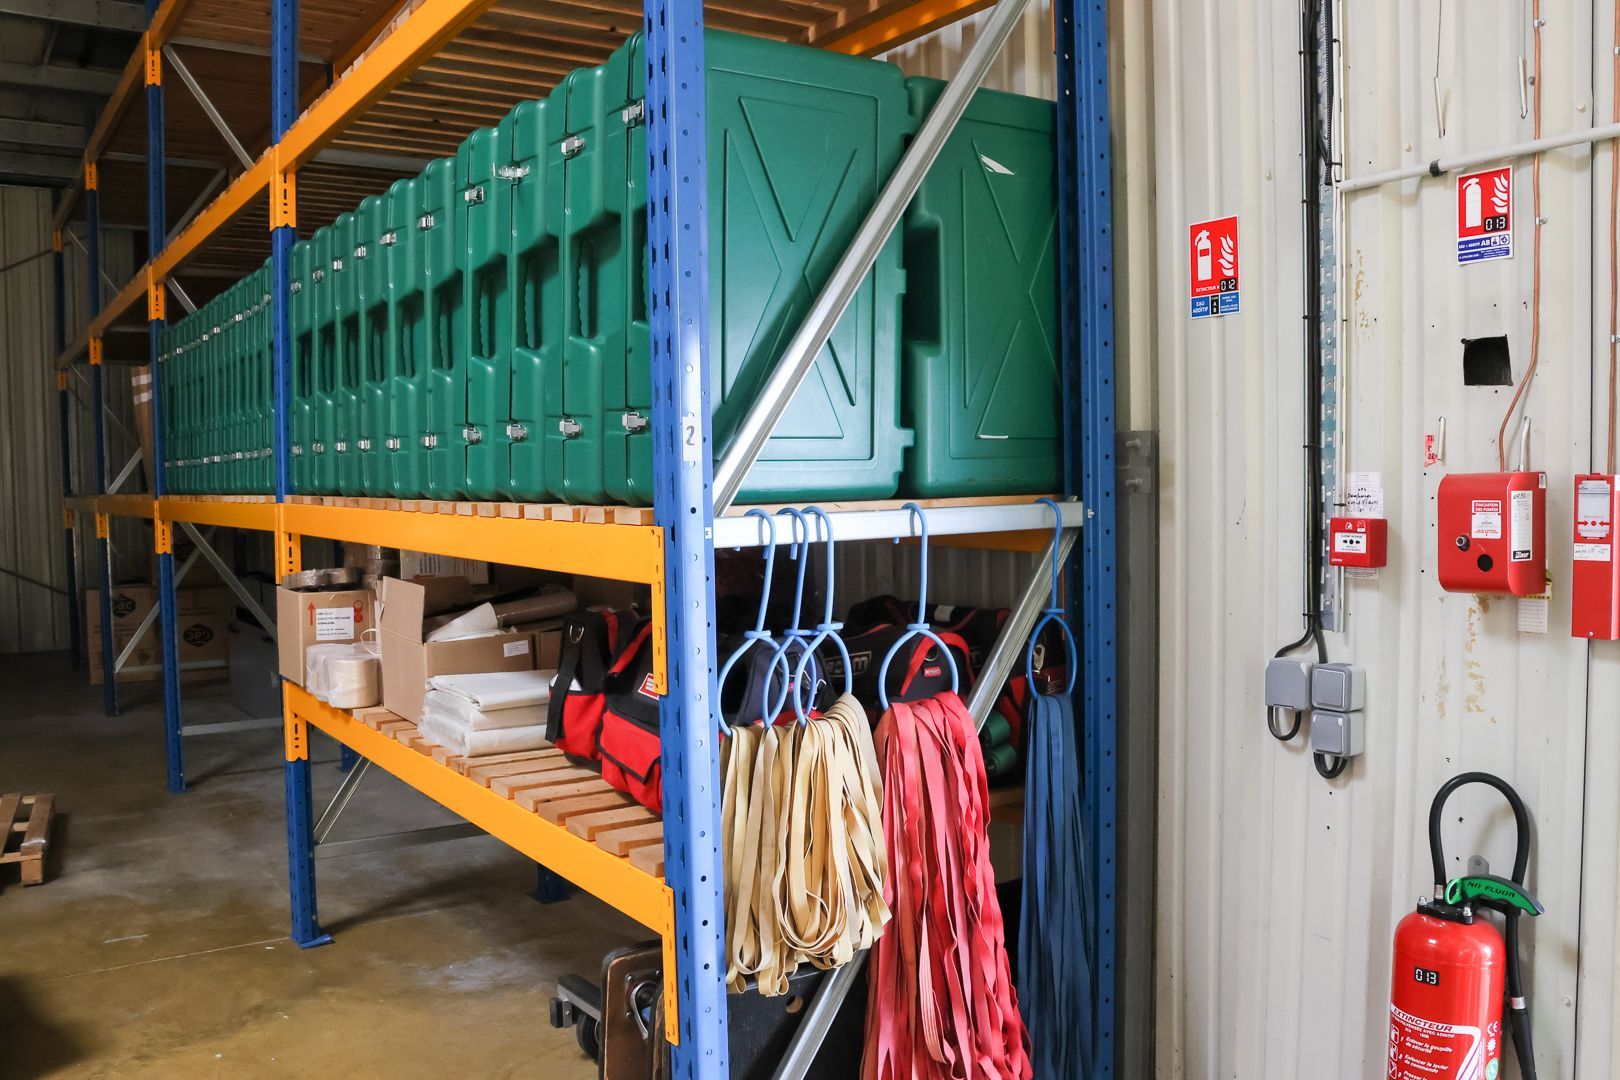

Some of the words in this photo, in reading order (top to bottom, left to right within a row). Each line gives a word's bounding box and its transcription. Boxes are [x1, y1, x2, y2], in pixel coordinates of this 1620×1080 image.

[1486, 217, 1505, 230] 013
[1481, 239, 1491, 247] AB
[1221, 279, 1235, 290] 012
[685, 425, 695, 446] 2
[1467, 881, 1481, 889] NO
[1484, 886, 1516, 898] FLUOR
[1416, 969, 1436, 984] 013
[1393, 1008, 1453, 1032] EXTINCTEUR
